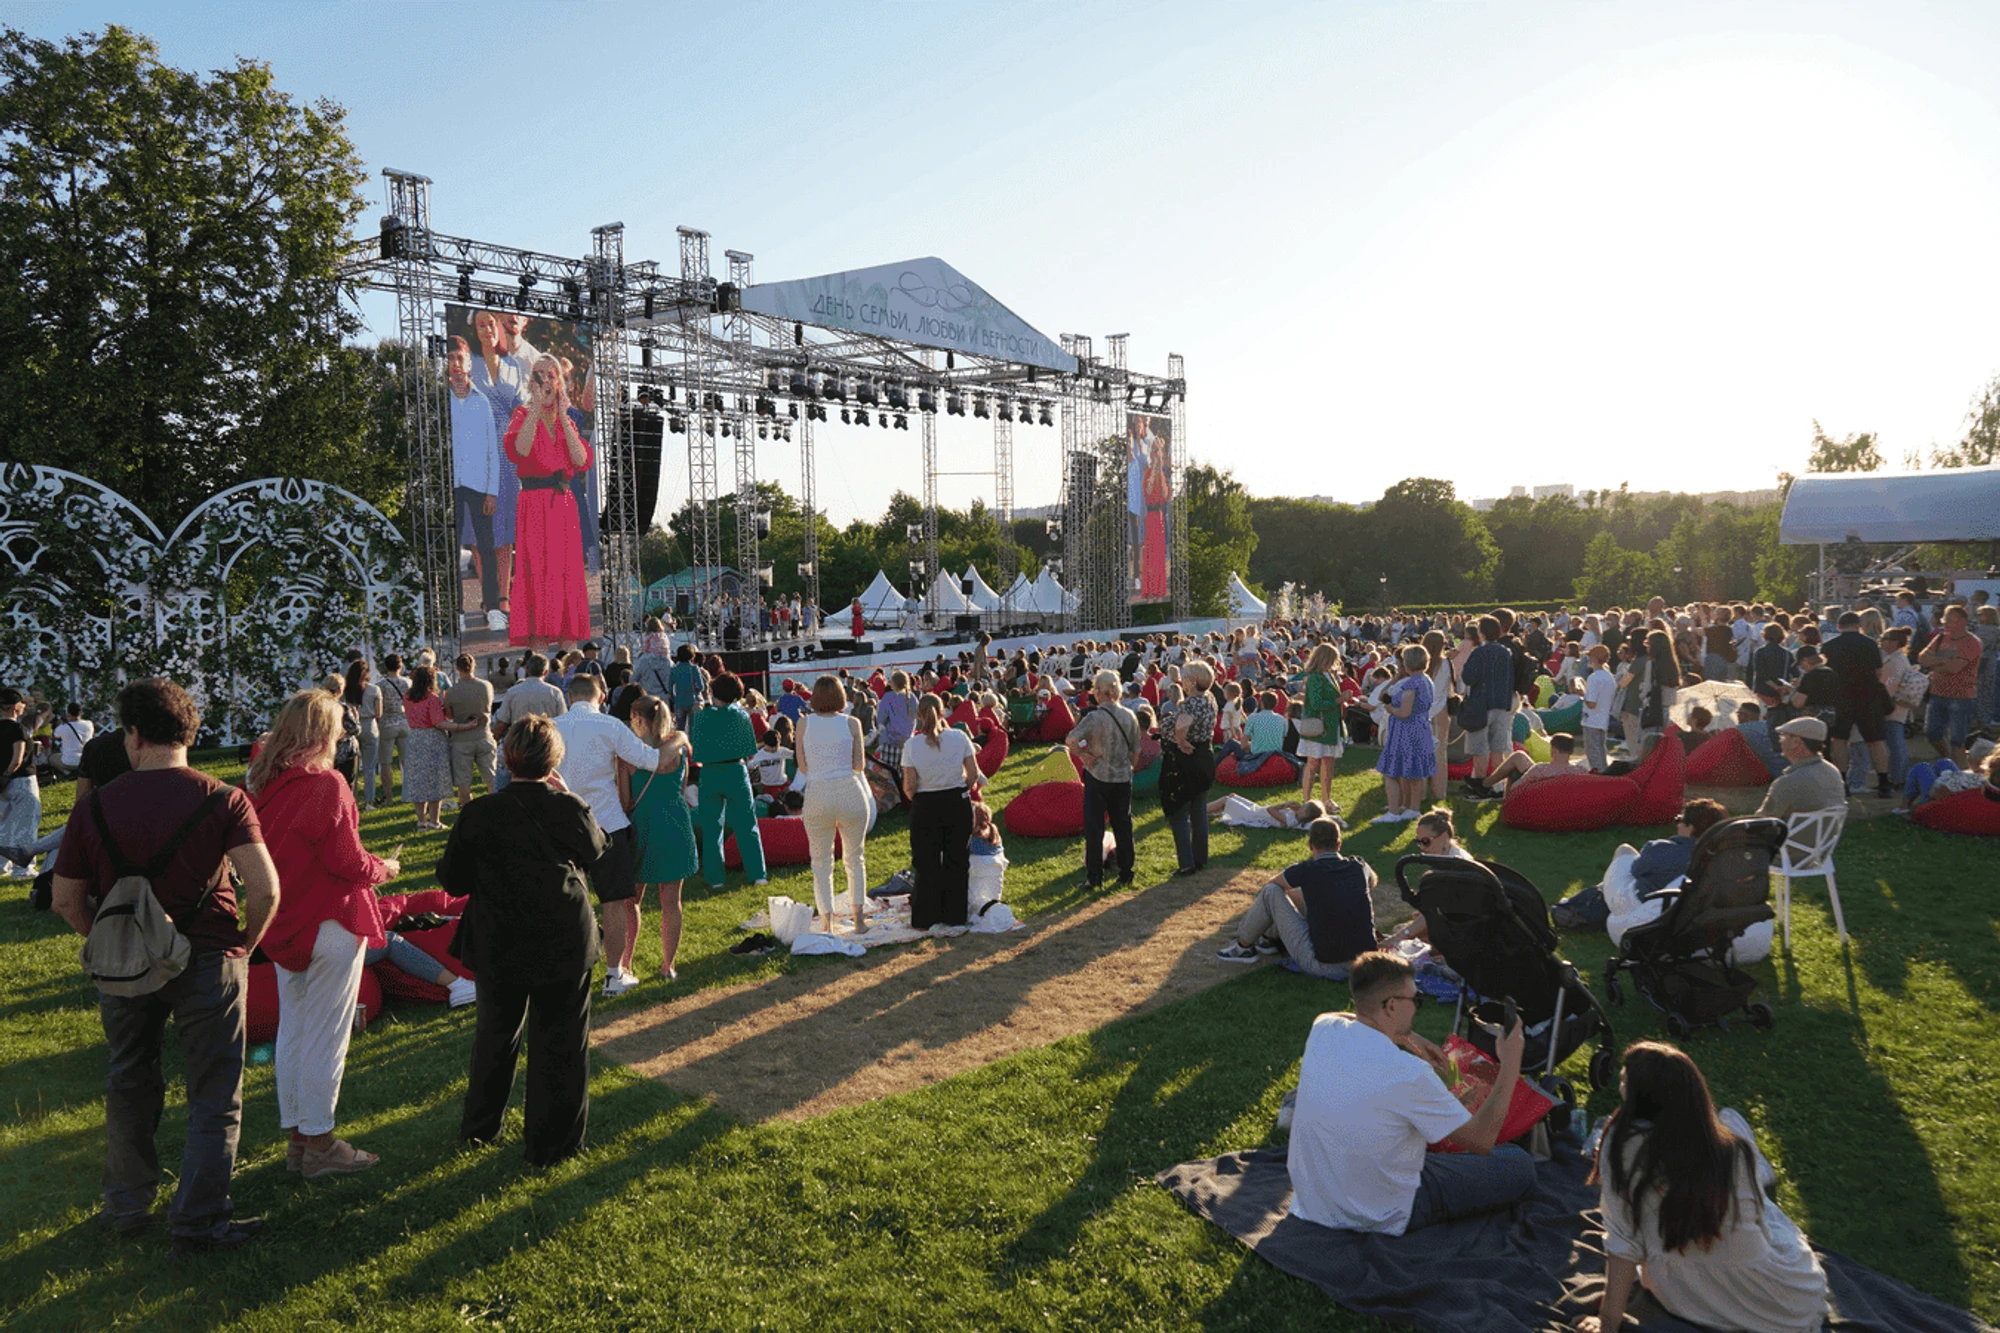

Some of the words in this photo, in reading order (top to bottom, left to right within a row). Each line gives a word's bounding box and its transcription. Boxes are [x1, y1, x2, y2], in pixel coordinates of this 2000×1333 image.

[813, 294, 854, 320] ДЕНЬ
[915, 316, 965, 344] ЛЮБВИ
[969, 325, 978, 345] И
[982, 329, 1039, 356] ВЕРНОСТИ
